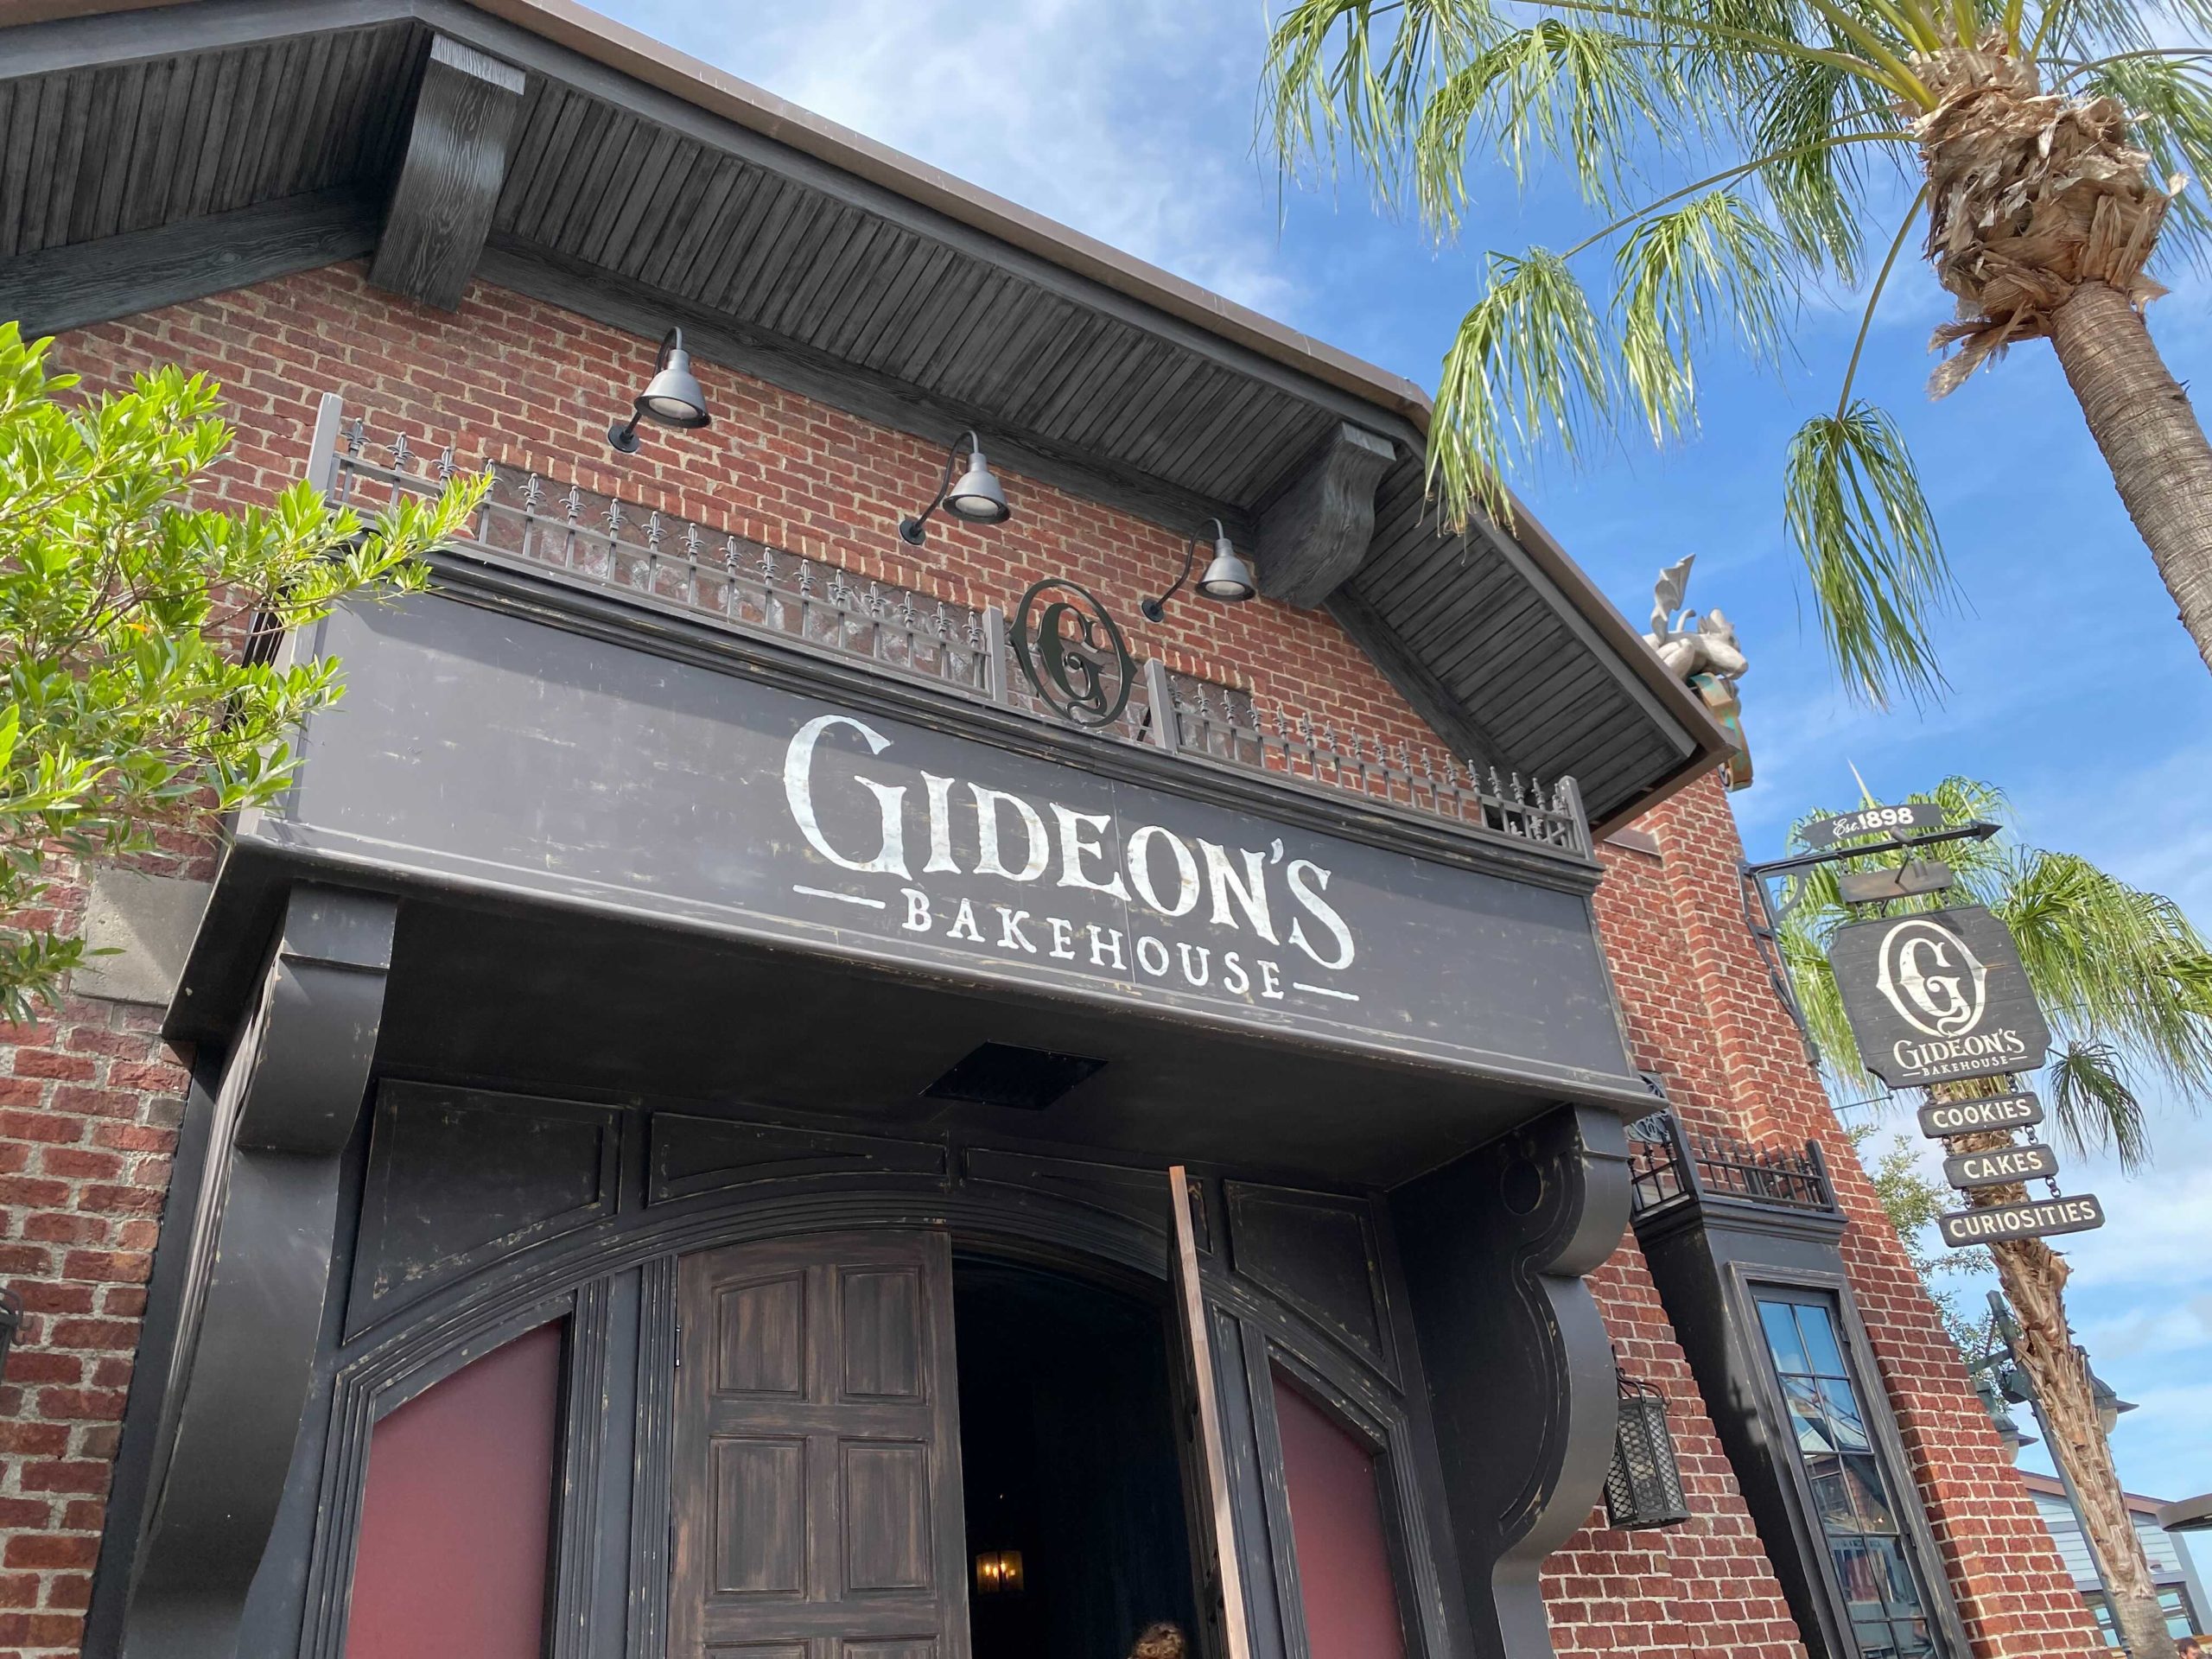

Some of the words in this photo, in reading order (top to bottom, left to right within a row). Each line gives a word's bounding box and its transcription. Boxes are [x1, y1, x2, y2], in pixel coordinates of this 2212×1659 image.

[1833, 817, 1859, 839] Est.
[1858, 807, 1914, 830] 1898
[783, 715, 1356, 969] GIDEON'S
[900, 888, 1286, 1000] BAKEHOUSE
[1893, 1027, 2025, 1070] GIDEON'S
[1921, 1055, 2009, 1077] BAKEHOUSE
[1932, 1098, 2031, 1128] COOKIES
[1963, 1151, 2043, 1179] CAKES
[1949, 1200, 2096, 1238] CURIOSITIES
